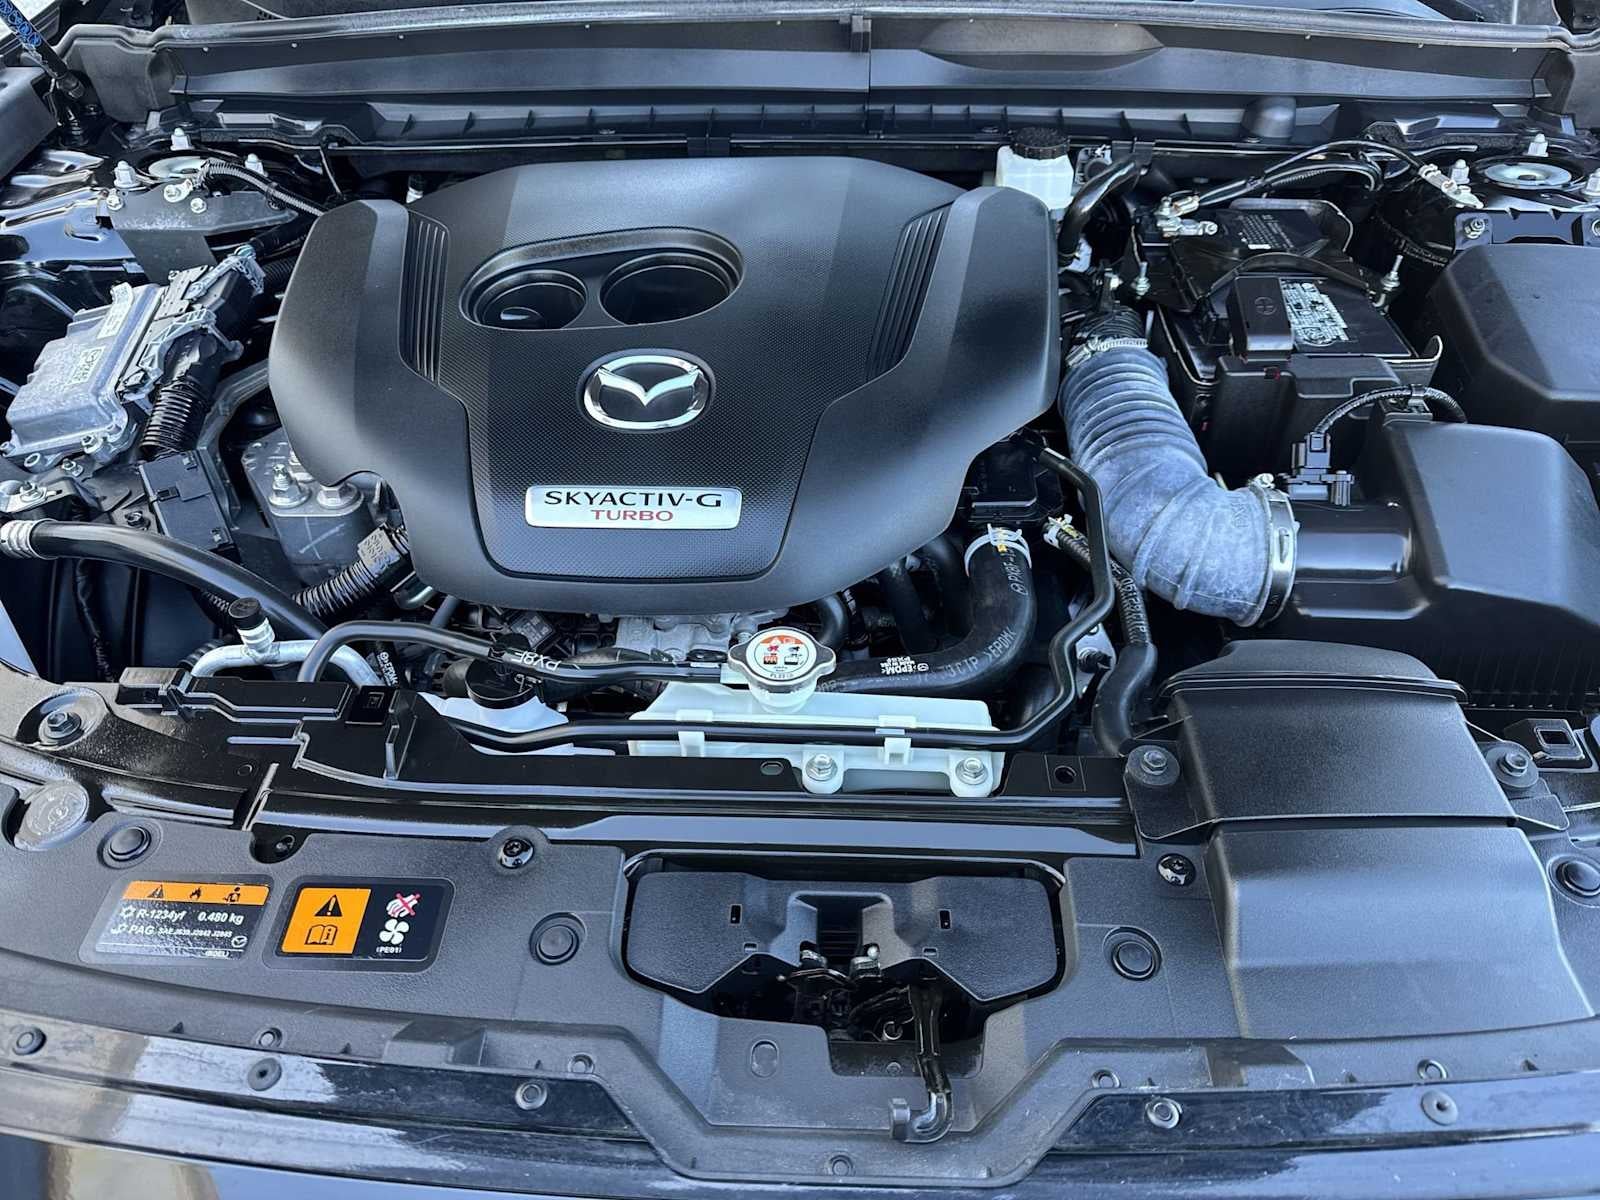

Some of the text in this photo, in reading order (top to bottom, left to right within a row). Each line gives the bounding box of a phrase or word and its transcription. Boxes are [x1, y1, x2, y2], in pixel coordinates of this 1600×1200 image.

[544, 490, 722, 508] SKYACTIV-G
[590, 509, 674, 522] TURBO
[510, 650, 562, 671] PX8F
[136, 909, 188, 922] R-1234yf
[229, 912, 245, 926] kg
[129, 924, 155, 935] PAG
